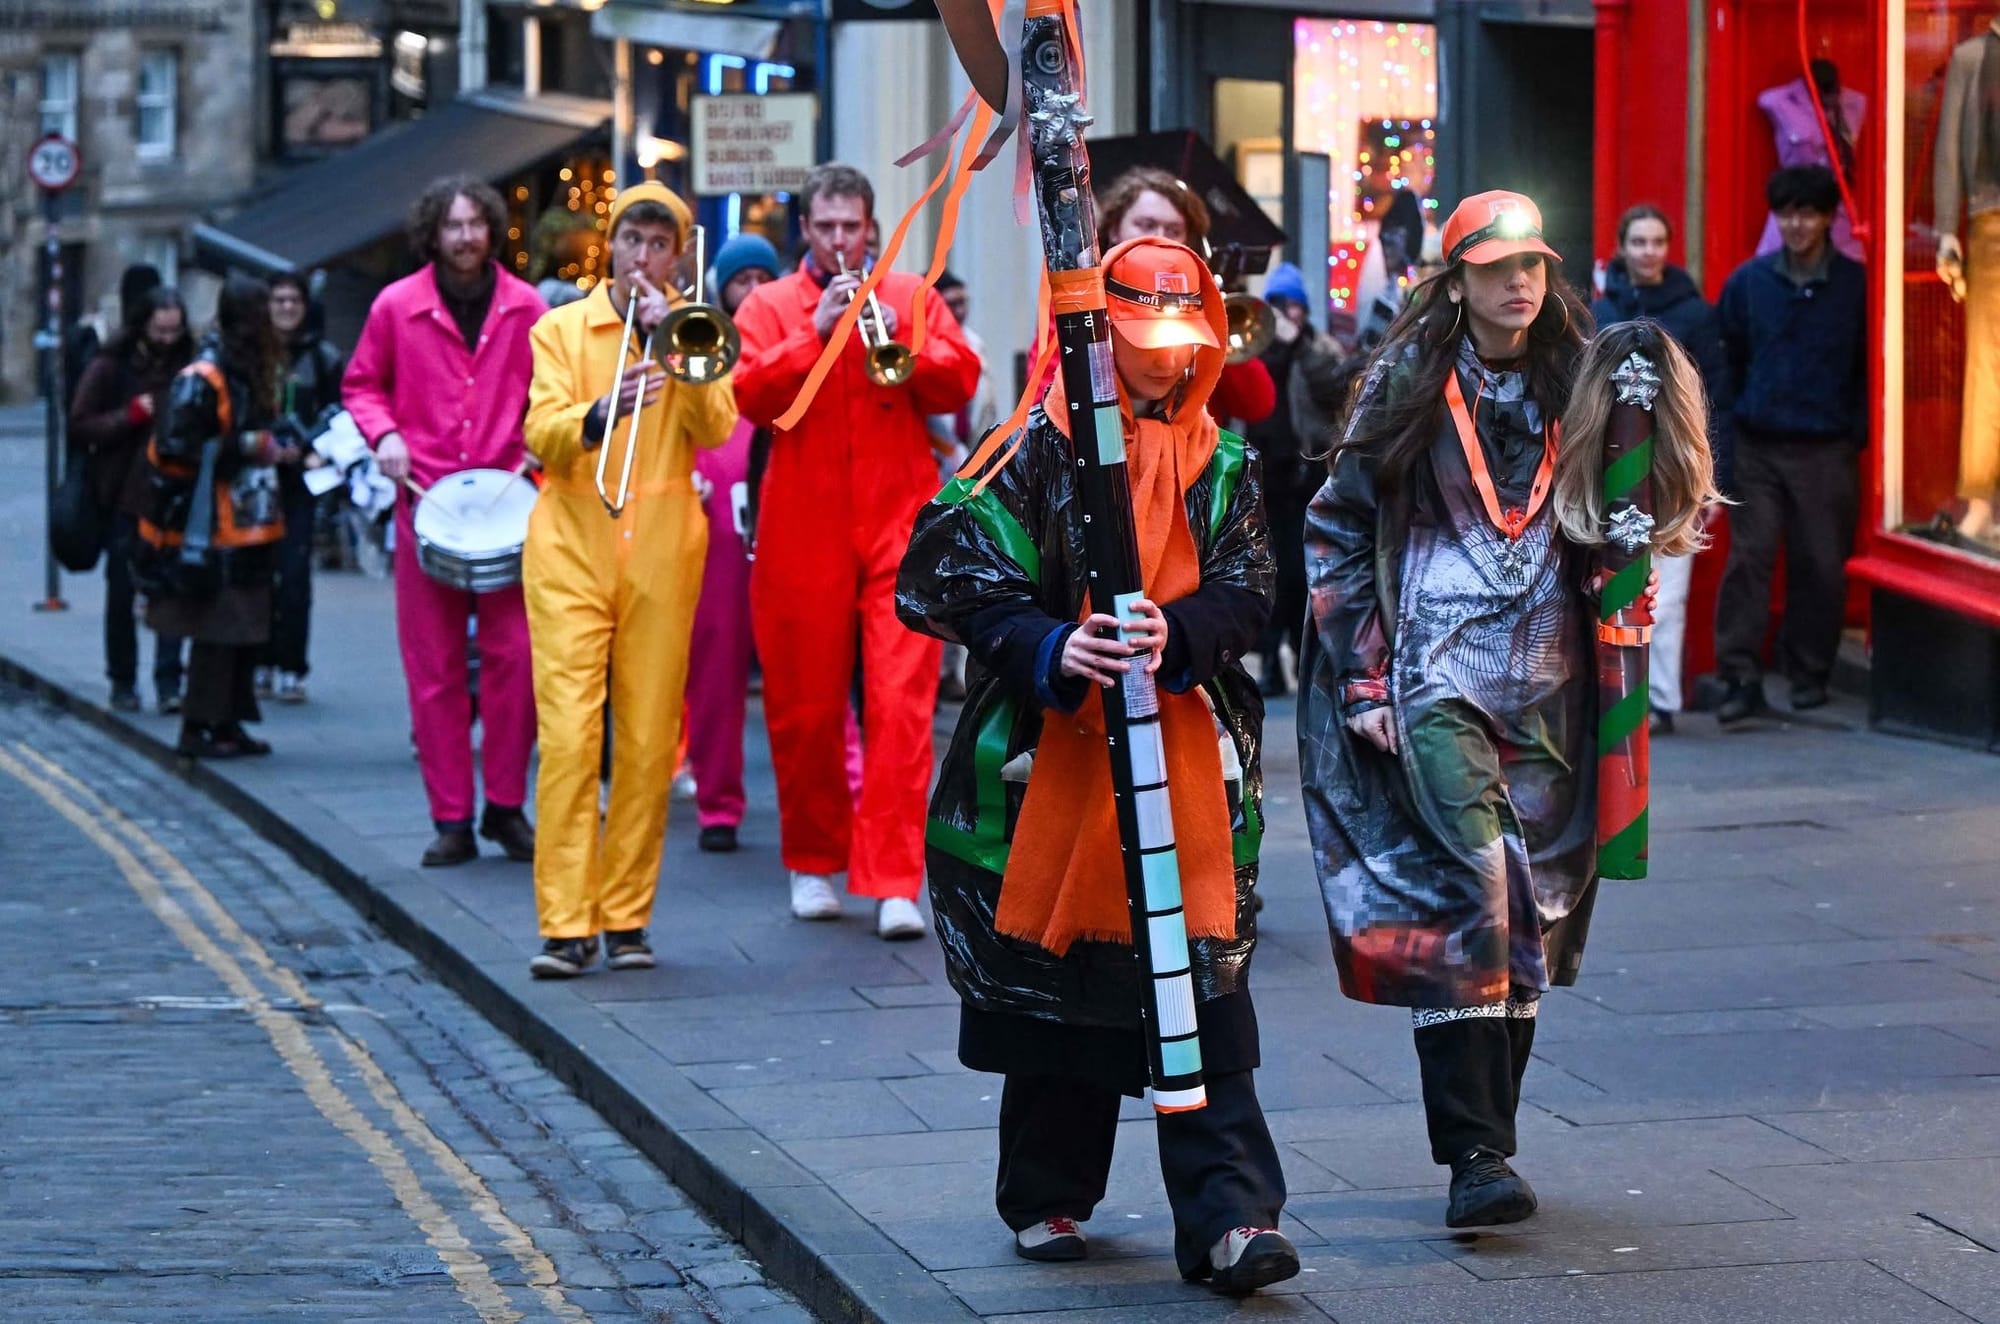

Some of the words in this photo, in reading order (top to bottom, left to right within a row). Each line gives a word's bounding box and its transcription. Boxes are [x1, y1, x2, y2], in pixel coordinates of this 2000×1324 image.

[1064, 346, 1073, 355] A
[1071, 402, 1079, 410] B
[1077, 458, 1086, 467] C
[1083, 514, 1091, 523] D
